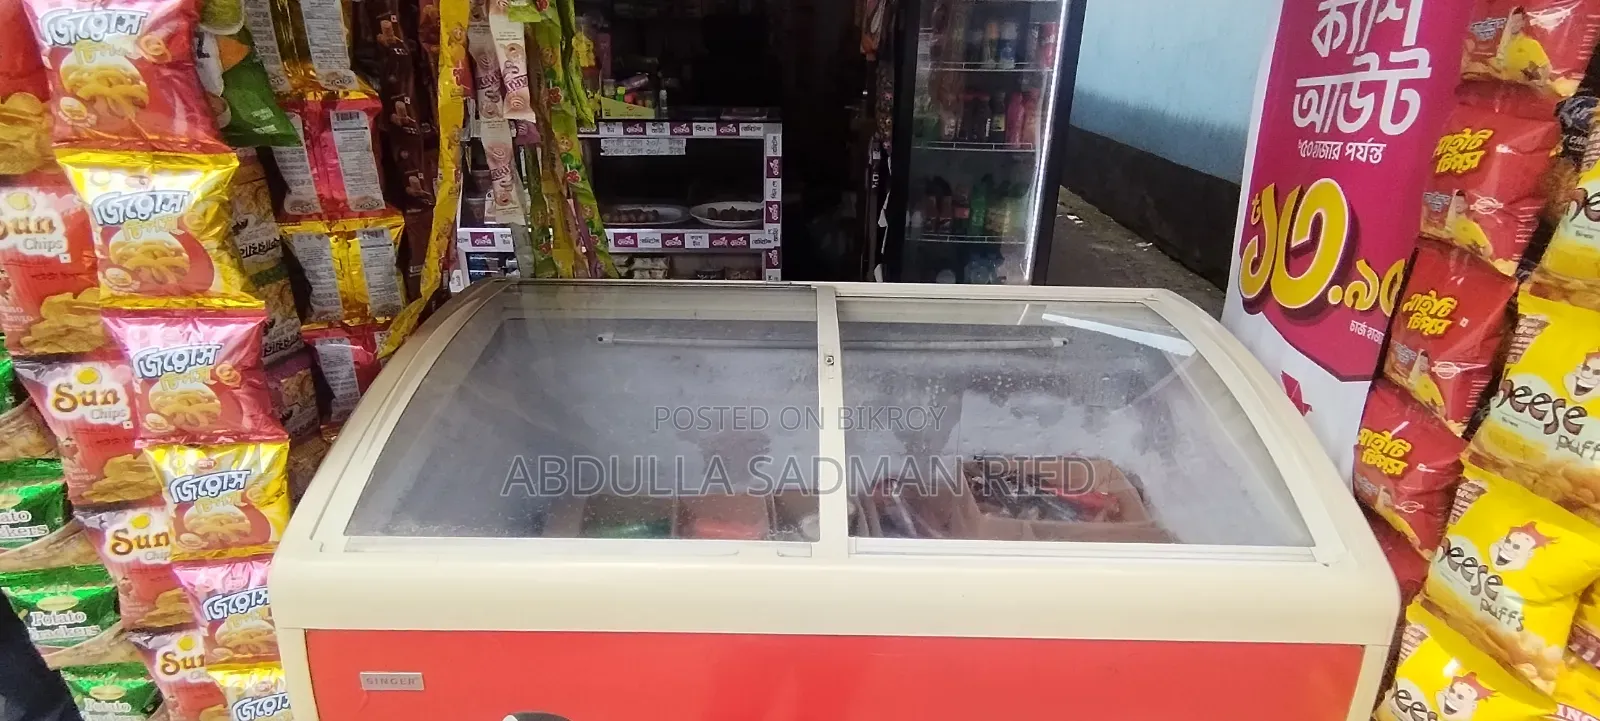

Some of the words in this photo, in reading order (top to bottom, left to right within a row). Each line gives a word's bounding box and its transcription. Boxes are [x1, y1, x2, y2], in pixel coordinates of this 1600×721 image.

[1311, 0, 1422, 57] ক্যাশ
[1293, 48, 1432, 136] আউট
[1345, 137, 1387, 164] পর্যন্ত
[23, 237, 64, 252] Chips
[53, 382, 121, 413] Sun
[91, 408, 127, 421] Chips
[111, 527, 170, 556] Sun
[145, 550, 171, 562] Chip
[30, 611, 87, 626] Potato
[1480, 598, 1525, 632] puffs
[366, 676, 415, 686] SINGER
[83, 697, 131, 714] Potato
